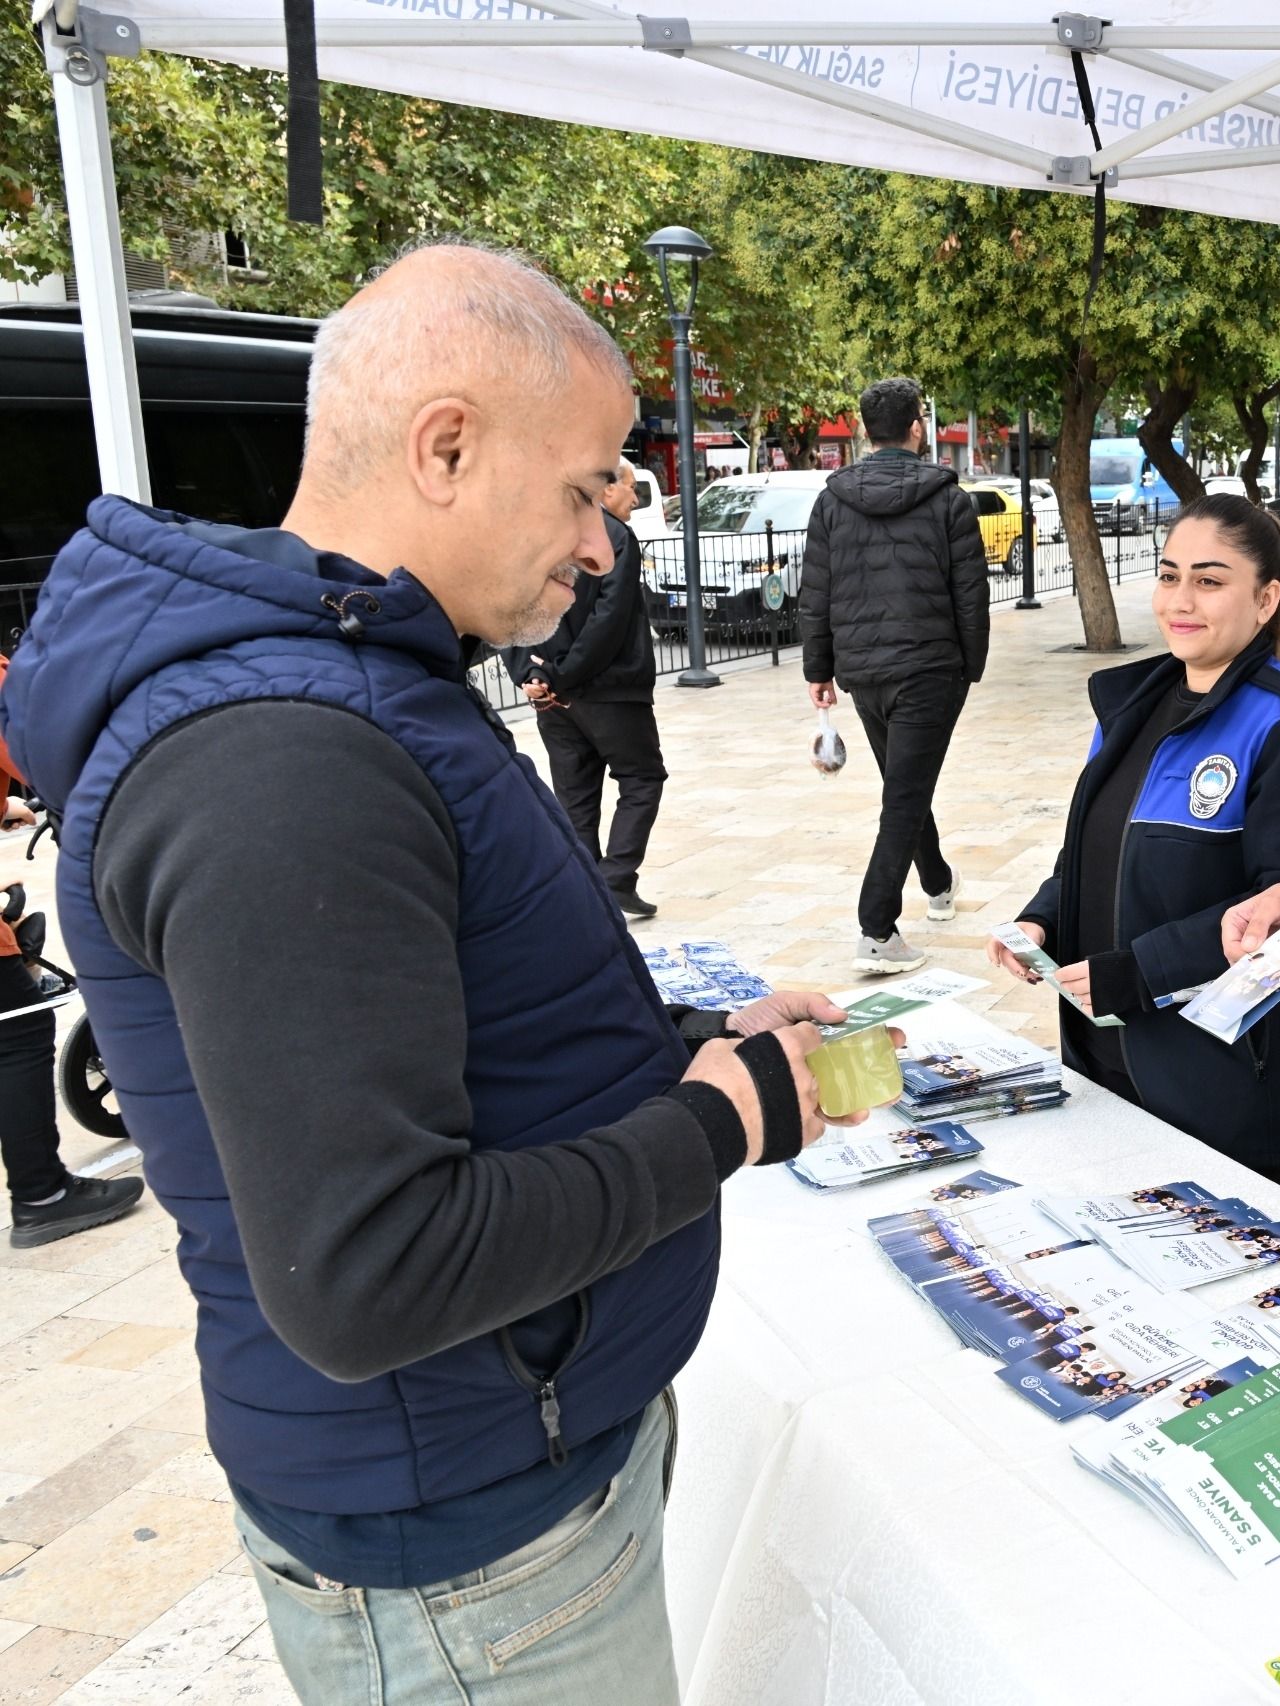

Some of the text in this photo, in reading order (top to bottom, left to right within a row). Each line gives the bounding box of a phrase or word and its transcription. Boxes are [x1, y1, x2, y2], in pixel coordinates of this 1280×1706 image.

[1253, 1461, 1270, 1472] ET
[1256, 1480, 1276, 1501] BAK
[1184, 1486, 1239, 1547] ALMADAN ÖNCE
[1198, 1477, 1262, 1546] 5 SANİYE
